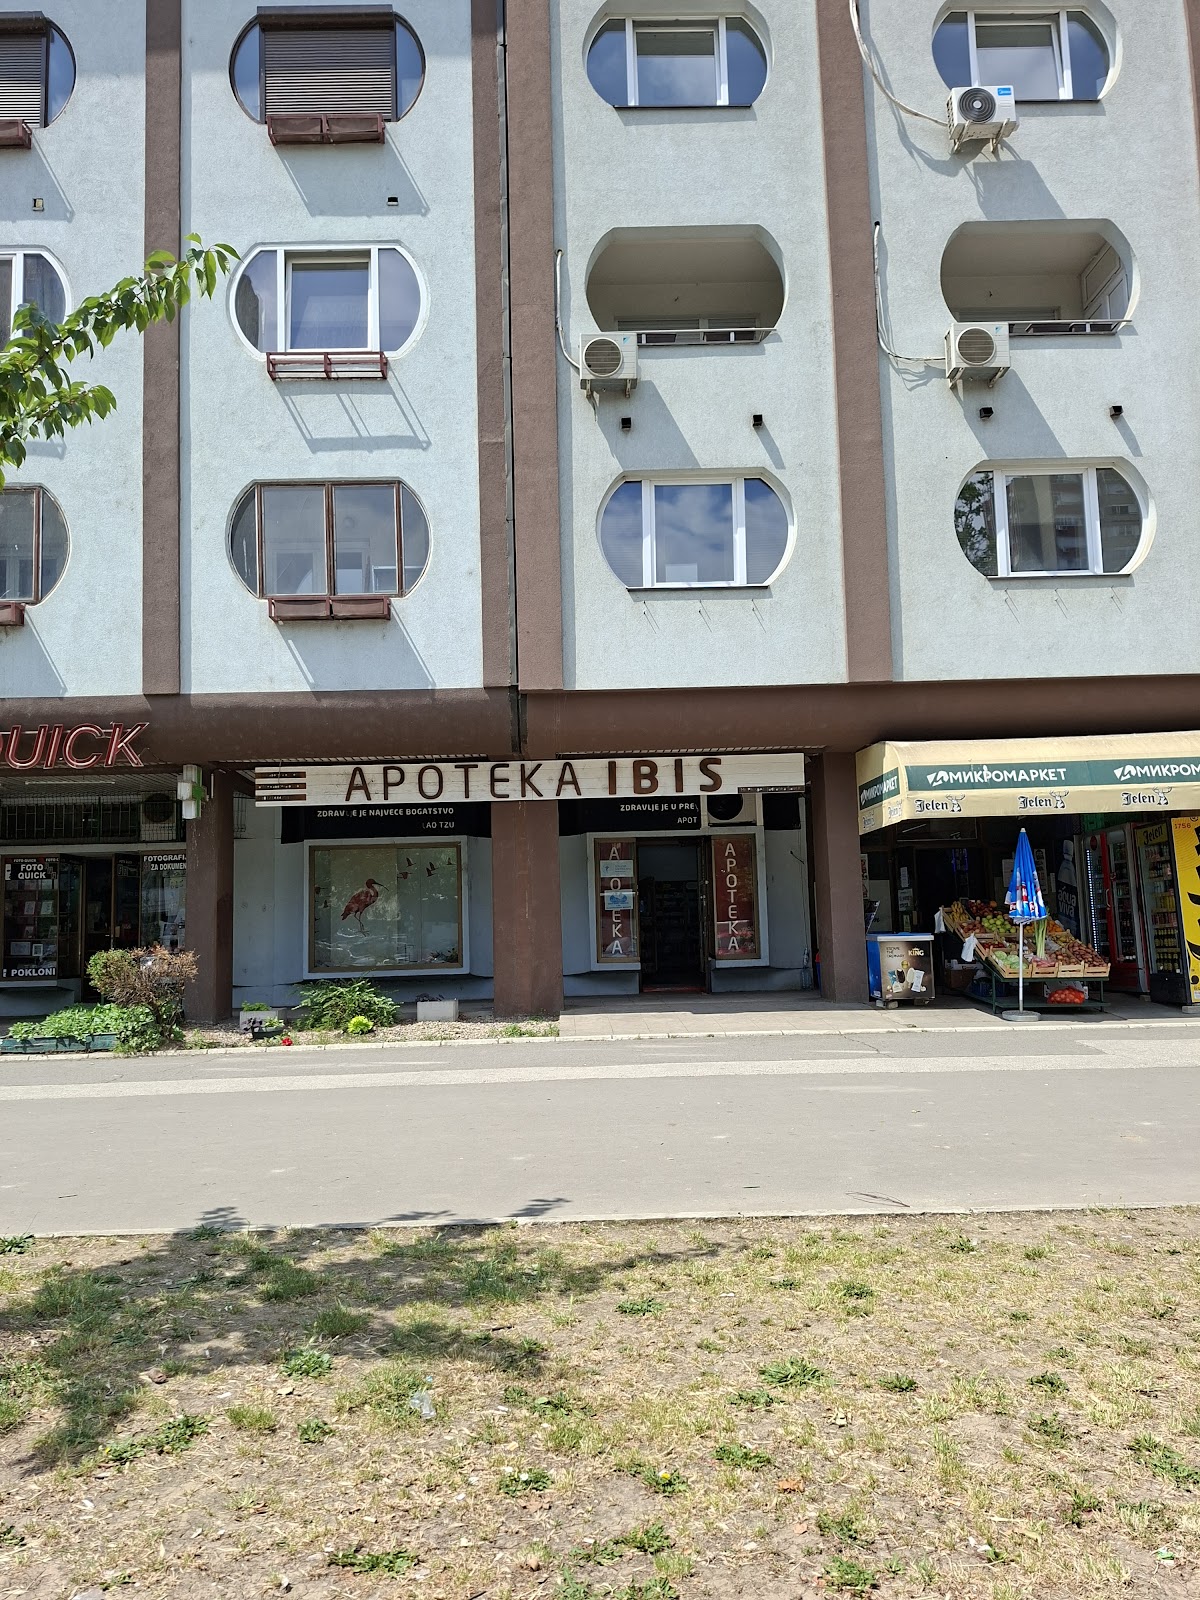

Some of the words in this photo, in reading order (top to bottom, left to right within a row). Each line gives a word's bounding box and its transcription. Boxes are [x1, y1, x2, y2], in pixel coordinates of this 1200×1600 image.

[0, 722, 149, 769] UICK
[345, 761, 582, 801] APOTEKA
[608, 758, 723, 795] IBIS
[950, 768, 1067, 784] МИКРОМАРКЕТ
[915, 799, 949, 812] Jelen
[1018, 796, 1052, 809] Jelen
[1122, 793, 1155, 806] Jelen
[359, 809, 367, 817] JE
[406, 807, 454, 816] BOGATSTVO
[620, 803, 659, 812] ZDRAVLJE
[661, 803, 669, 811] JE
[679, 802, 699, 812] PRE
[439, 821, 455, 829] TZU
[677, 816, 698, 824] APOT
[1143, 825, 1164, 845] Jelen
[144, 854, 187, 862] FOTOGRAFI
[609, 847, 622, 954] AOEKA
[725, 843, 739, 950] APOTEKA
[11, 968, 56, 977] POKLONI
